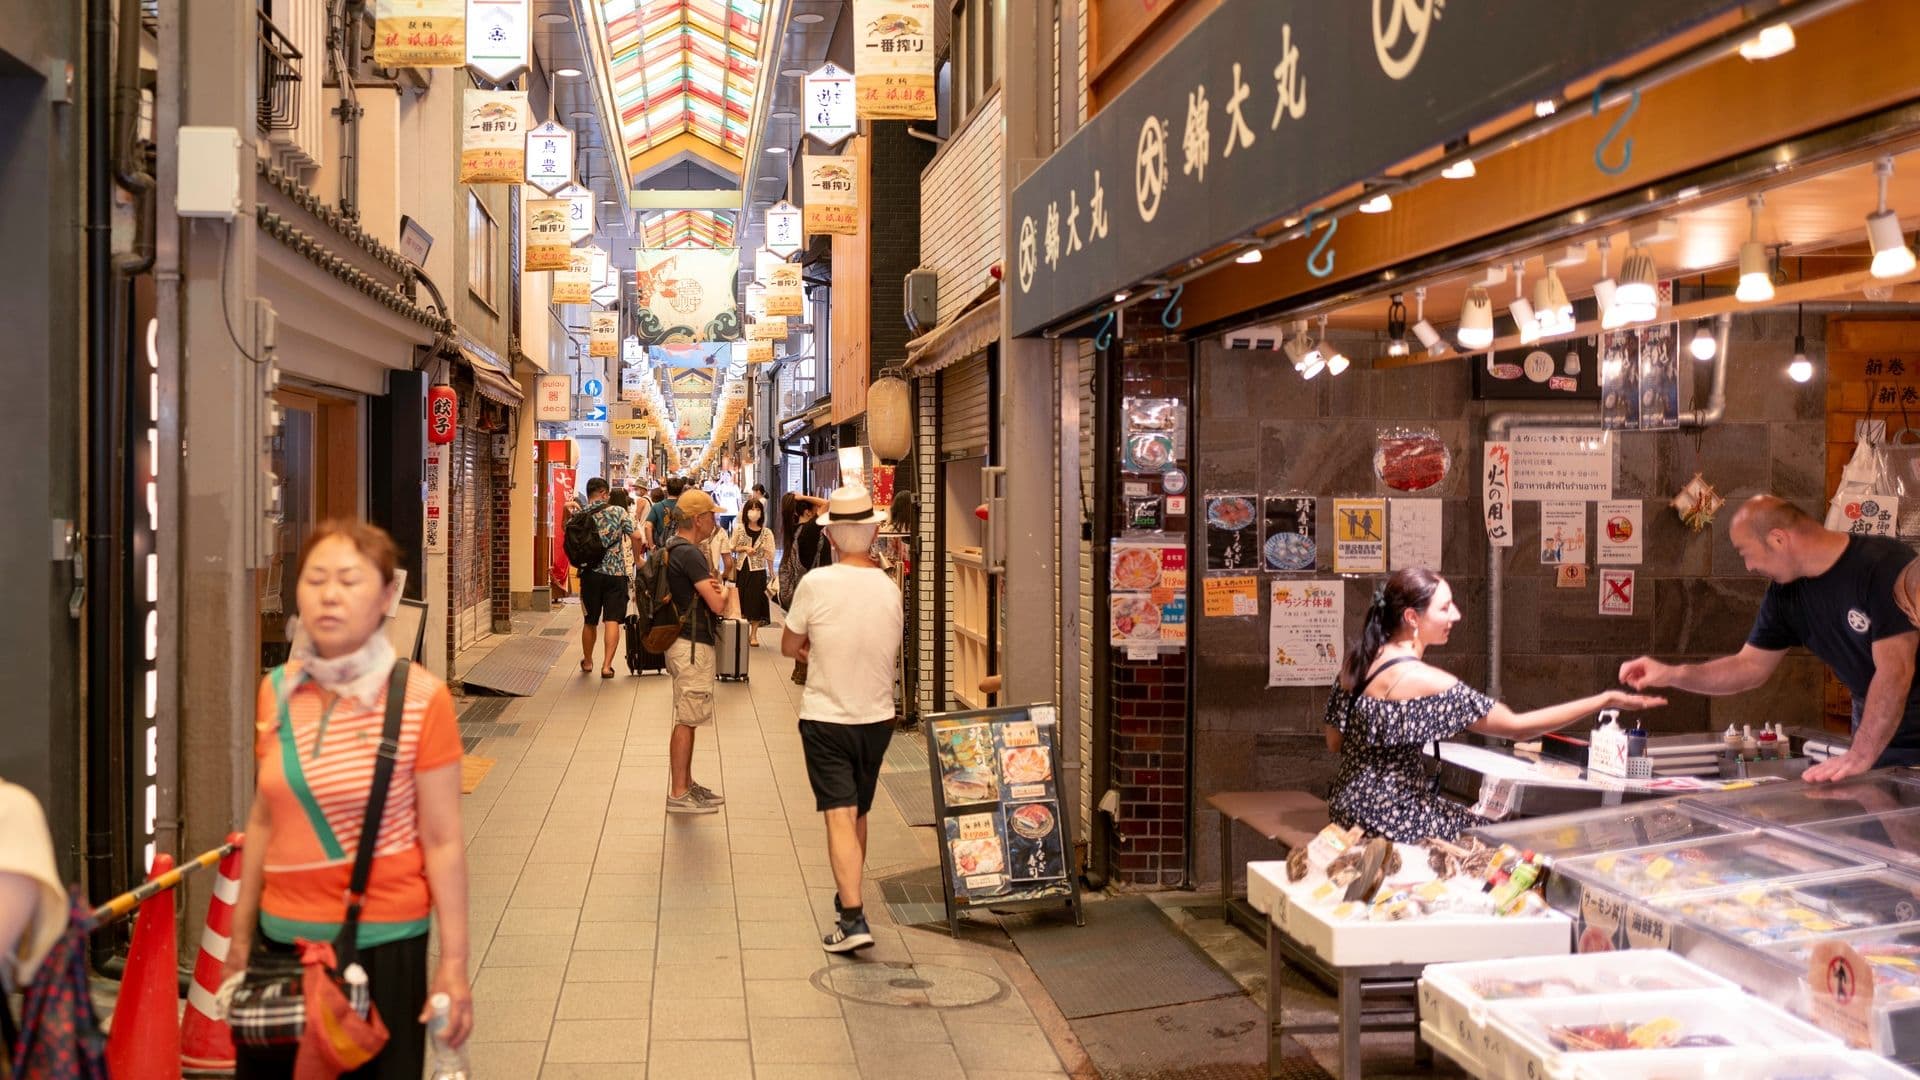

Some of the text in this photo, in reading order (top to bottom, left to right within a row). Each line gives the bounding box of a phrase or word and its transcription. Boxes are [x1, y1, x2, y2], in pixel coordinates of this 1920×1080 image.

[865, 38, 924, 53] 一番搾り
[1182, 23, 1307, 184] 錦大丸
[470, 120, 518, 132] 一番搾り
[811, 180, 852, 192] 一番搾り
[531, 223, 567, 233] 一番搾り
[1044, 169, 1109, 273] 錦大丸
[770, 279, 798, 287] 一番搾り
[1865, 358, 1907, 376] 新巻
[1879, 387, 1920, 404] 新巻
[433, 398, 452, 434] 餃子
[1487, 464, 1508, 539] 火の用心
[1223, 546, 1234, 570] 寿司
[1027, 854, 1039, 879] 寿司
[1632, 910, 1664, 943] 海鮮丼
